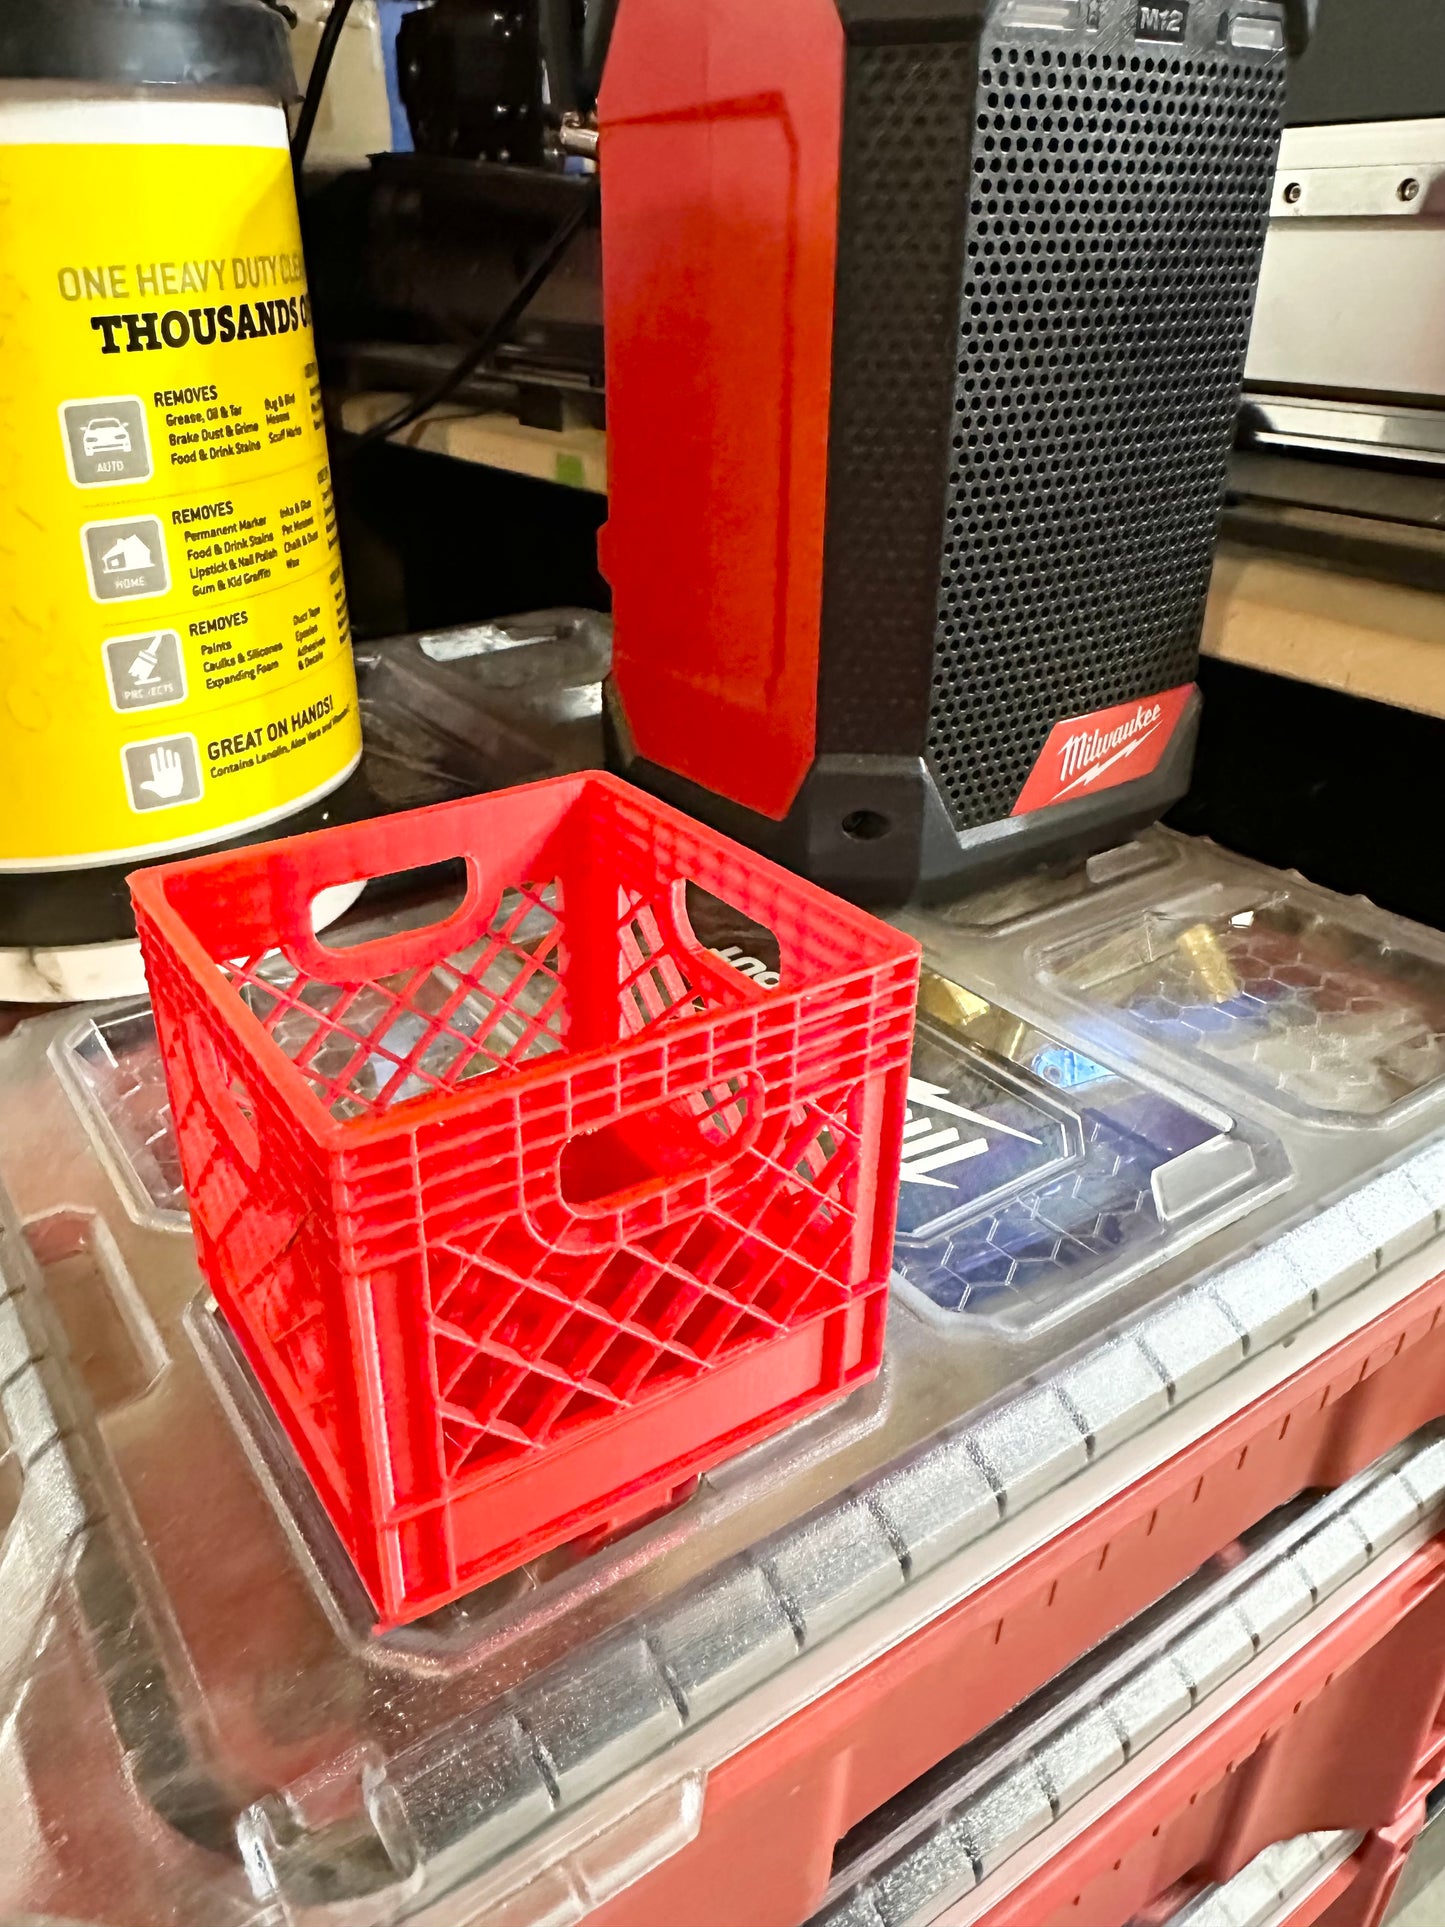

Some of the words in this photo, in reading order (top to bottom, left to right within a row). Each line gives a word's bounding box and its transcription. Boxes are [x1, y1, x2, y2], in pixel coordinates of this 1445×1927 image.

[1139, 7, 1184, 33] M12
[58, 264, 129, 302] ONE
[136, 258, 226, 297] HEAVY
[232, 255, 279, 289] DUTY
[91, 297, 298, 354] THOUSANDS
[154, 384, 218, 407] REMOVES
[166, 412, 205, 427] Grease,
[220, 406, 229, 418] &
[230, 404, 242, 417] Tar
[169, 432, 200, 446] Brake
[201, 427, 224, 441] Dust
[226, 425, 234, 437] &
[235, 422, 259, 436] Grime
[171, 450, 197, 465] Food
[199, 448, 208, 461] &
[210, 444, 235, 460] Drink
[235, 440, 261, 454] Stains
[97, 460, 124, 472] AUTO
[172, 500, 234, 525] REMOVES
[184, 523, 238, 542] Permanent
[239, 516, 267, 531] Marker
[187, 545, 212, 560] Food
[214, 543, 222, 555] &
[224, 537, 248, 553] Drink
[249, 532, 274, 547] Stains
[190, 561, 228, 581] Lipstick
[229, 558, 237, 570] &
[238, 553, 255, 568] Nail
[115, 576, 145, 589] HOME
[192, 583, 215, 597] Gum
[217, 579, 226, 591] &
[227, 575, 242, 588] Kid
[189, 610, 249, 637] REMOVES
[201, 641, 232, 655] Paints
[203, 657, 236, 673] Caulks
[238, 652, 246, 664] &
[206, 668, 257, 690] Expanding
[256, 660, 279, 674] Foam
[207, 728, 263, 760] GREAT
[266, 718, 288, 742] ON
[1058, 704, 1161, 781] Milwaukee
[210, 758, 254, 779] Contains
